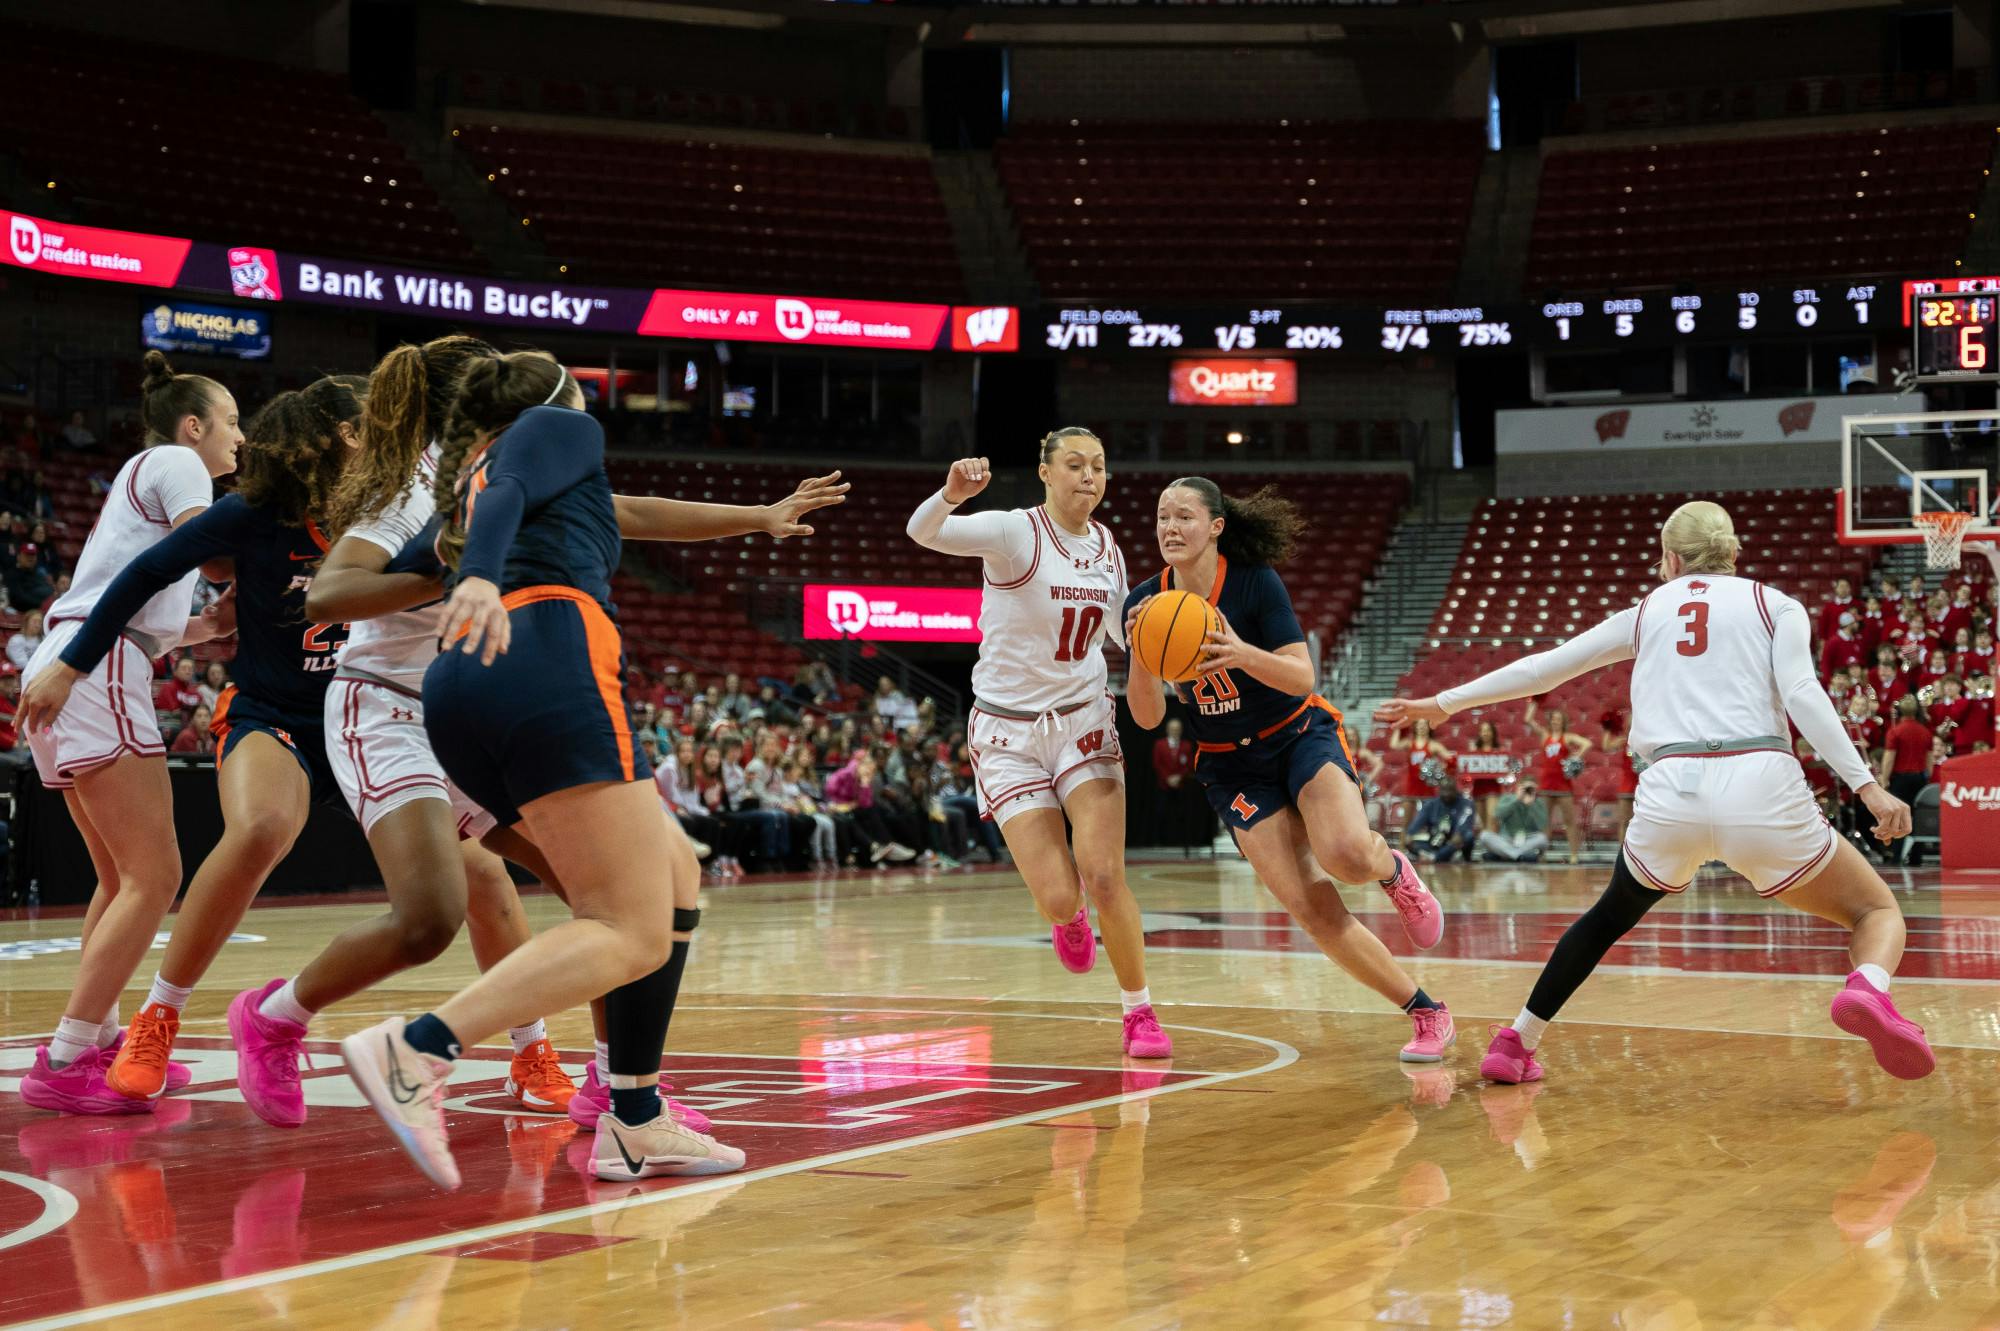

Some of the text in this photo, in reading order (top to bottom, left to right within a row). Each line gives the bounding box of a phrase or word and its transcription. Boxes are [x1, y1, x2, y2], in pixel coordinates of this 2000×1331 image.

[42, 246, 141, 272] credit union
[300, 264, 382, 300] Bank
[395, 275, 472, 310] With
[1794, 290, 1820, 303] STL
[1847, 286, 1876, 300] AST
[1542, 302, 1585, 317] OREB
[1604, 299, 1643, 314] DREB
[1672, 296, 1701, 309] REB
[1738, 293, 1759, 306] TO
[682, 307, 758, 325] ONLY AT
[1061, 310, 1142, 324] FIELD GOAL
[1250, 310, 1281, 324] 3-PT
[1385, 308, 1483, 324] FREE THROWS
[1677, 311, 1695, 332] 6
[1739, 308, 1756, 329] 5
[1797, 305, 1817, 326] 0
[1855, 302, 1867, 323] 1
[174, 311, 260, 337] NICHOLAS
[812, 318, 910, 338] credit union
[1557, 319, 1569, 339] 1
[1616, 315, 1633, 336] 5
[1047, 323, 1182, 349] 3/11 27%
[1215, 325, 1342, 351] 1/5 20%
[1382, 323, 1512, 351] 3/4 75%
[1961, 326, 1985, 367] 6
[1190, 367, 1275, 397] Quartz
[1050, 586, 1110, 603] WISCONSIN
[868, 609, 972, 629] credit union
[1676, 601, 1709, 657] 3
[1054, 606, 1104, 662] 10
[1192, 667, 1239, 704] 20
[1199, 698, 1241, 716] ILLINI
[1076, 729, 1104, 756] W
[1961, 786, 2000, 802] MU
